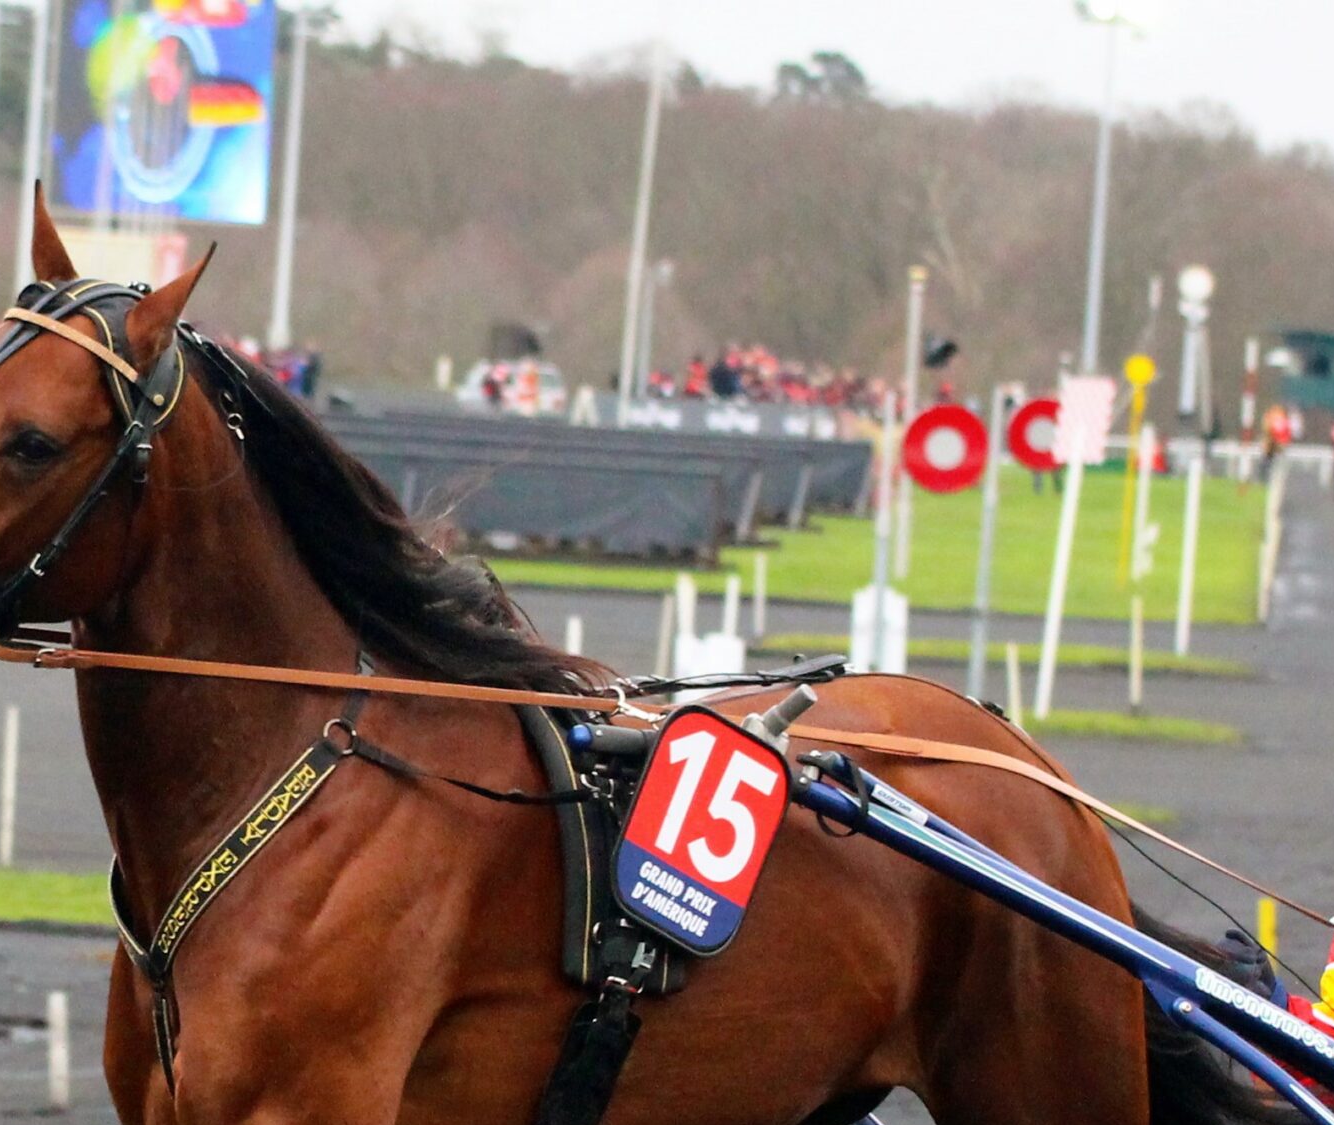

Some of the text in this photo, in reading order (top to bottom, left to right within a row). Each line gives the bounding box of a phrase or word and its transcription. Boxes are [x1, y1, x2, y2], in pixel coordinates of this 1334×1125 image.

[157, 763, 317, 954] READLY EXPRESS
[654, 730, 779, 883] 15
[630, 882, 709, 938] D'AMÉRIQUE
[639, 861, 718, 918] GRAND PRIX
